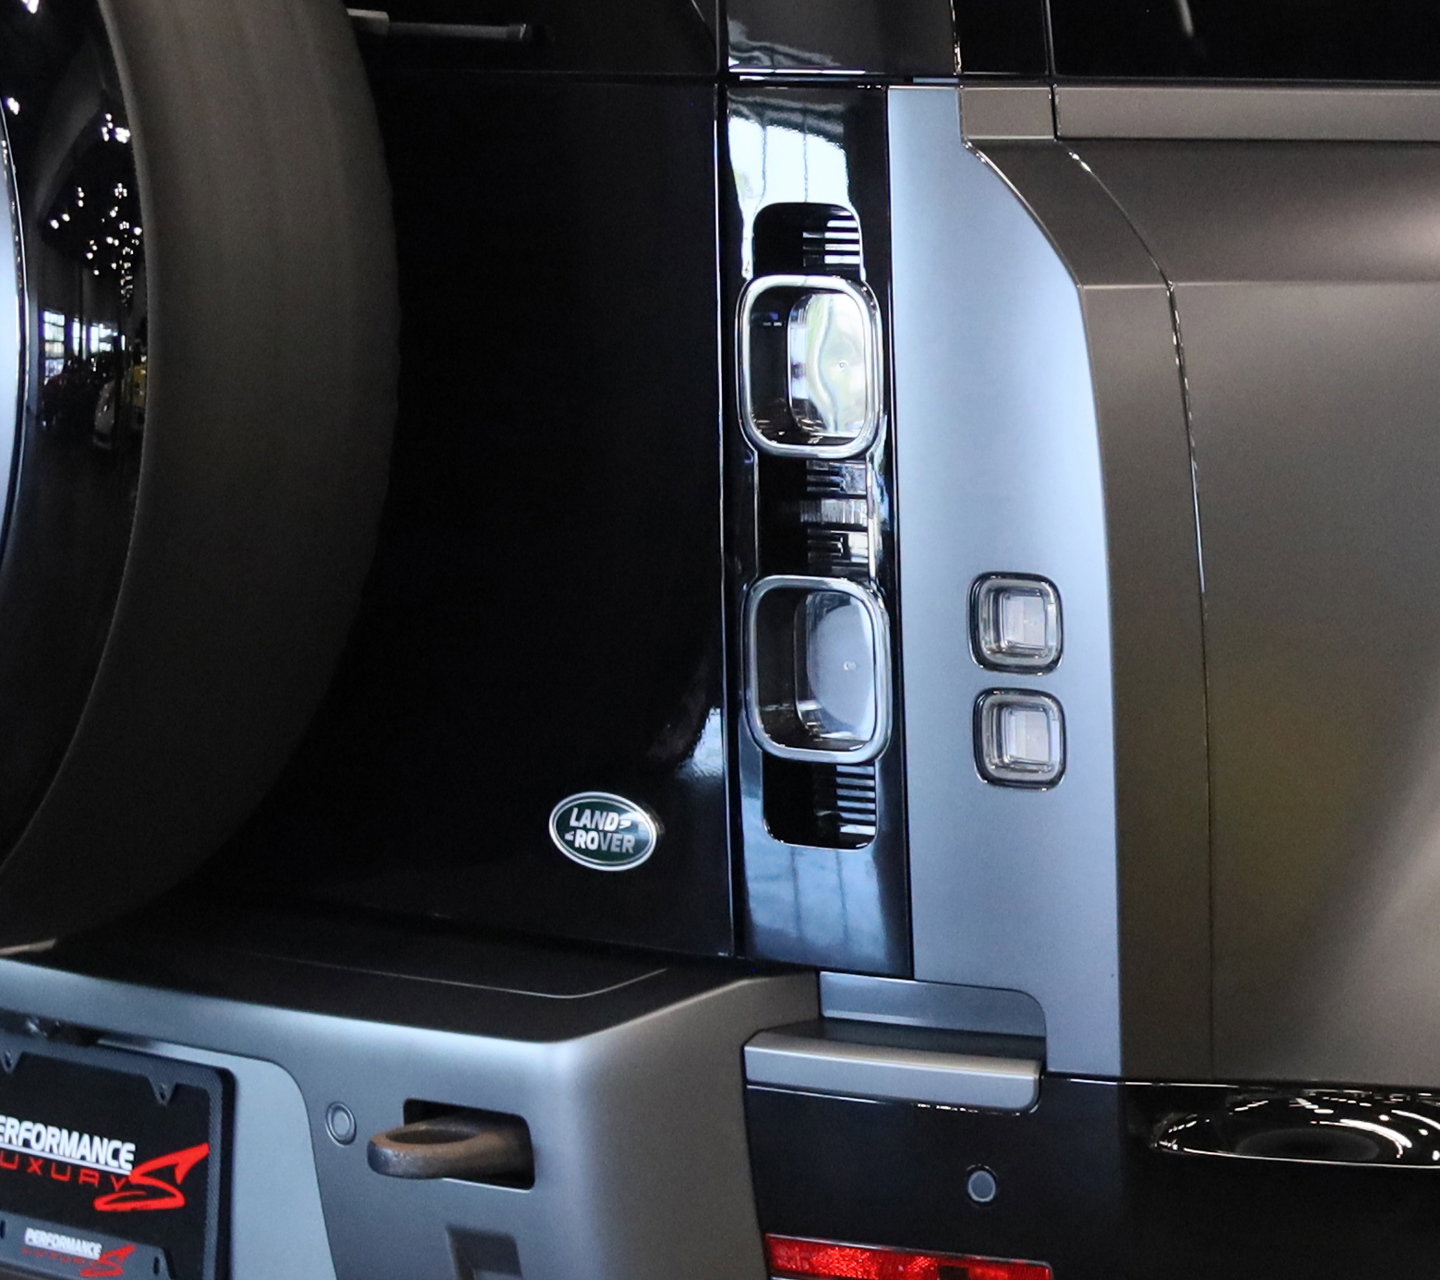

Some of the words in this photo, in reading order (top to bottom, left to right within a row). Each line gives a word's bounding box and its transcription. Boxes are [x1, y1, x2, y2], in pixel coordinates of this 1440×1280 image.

[569, 807, 620, 832] LAND
[574, 829, 636, 854] ROVER
[25, 1227, 103, 1259] PERFORMANCE
